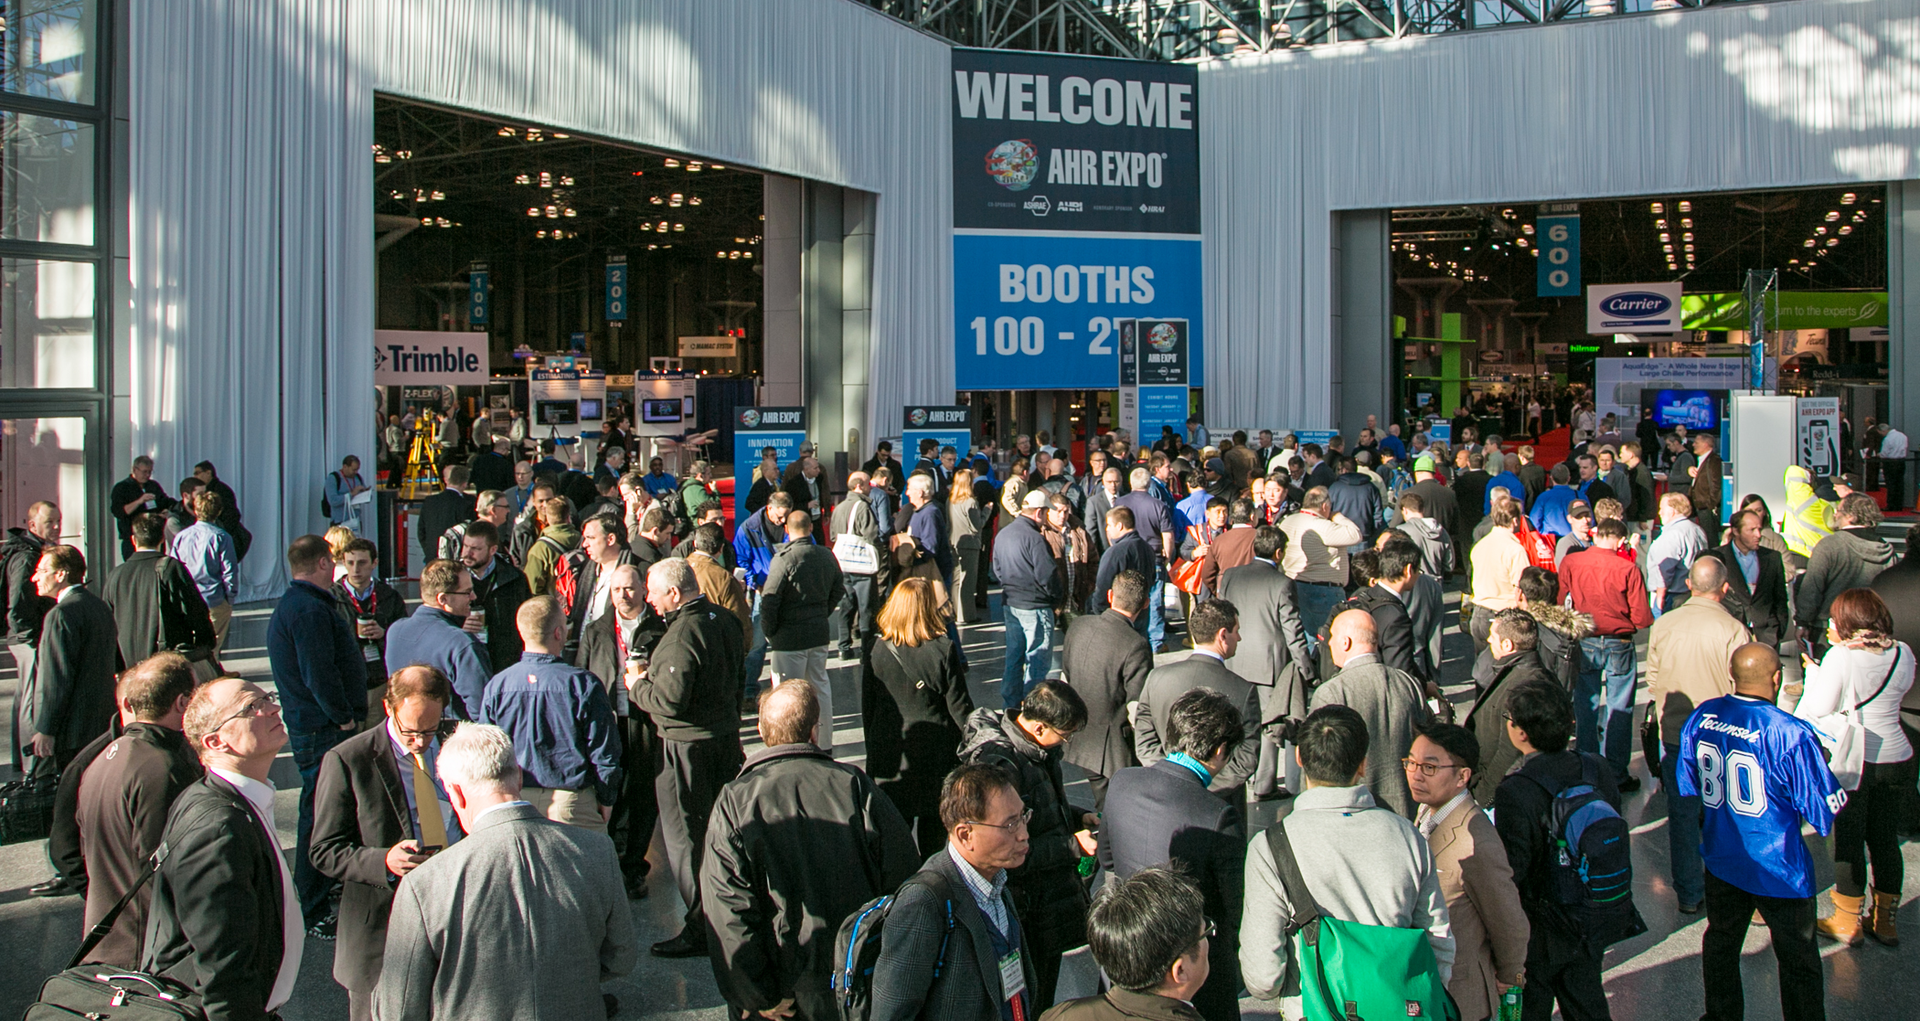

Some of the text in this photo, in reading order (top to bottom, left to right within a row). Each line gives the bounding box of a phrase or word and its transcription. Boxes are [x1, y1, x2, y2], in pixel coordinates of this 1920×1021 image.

[955, 70, 1193, 130] WELCOME
[1047, 148, 1098, 185] AHR
[1023, 200, 1047, 211] ASHRAE
[1548, 224, 1569, 288] 600
[999, 263, 1155, 304] BOOTHS
[474, 277, 484, 318] 100
[611, 270, 622, 314] 200
[1609, 297, 1662, 311] Carrier
[1795, 306, 1804, 316] to
[1807, 305, 1821, 316] the
[1823, 306, 1856, 318] experts
[970, 316, 1044, 356] 100
[1058, 332, 1074, 340] -
[1570, 344, 1600, 352] hilmor
[1148, 354, 1160, 363] AHR
[1719, 363, 1740, 371] Stage
[537, 372, 575, 380] ESTIMATING
[1640, 370, 1660, 378] Large
[404, 389, 433, 398] Z-FLEX
[762, 412, 779, 424] AHR
[929, 411, 946, 422] AHR
[1801, 408, 1812, 416] AHR
[1812, 408, 1825, 416] EXPO
[748, 438, 793, 447] INNOVATION
[1698, 713, 1761, 743] Tecumseh
[1696, 739, 1768, 818] 80
[1825, 787, 1848, 815] 80
